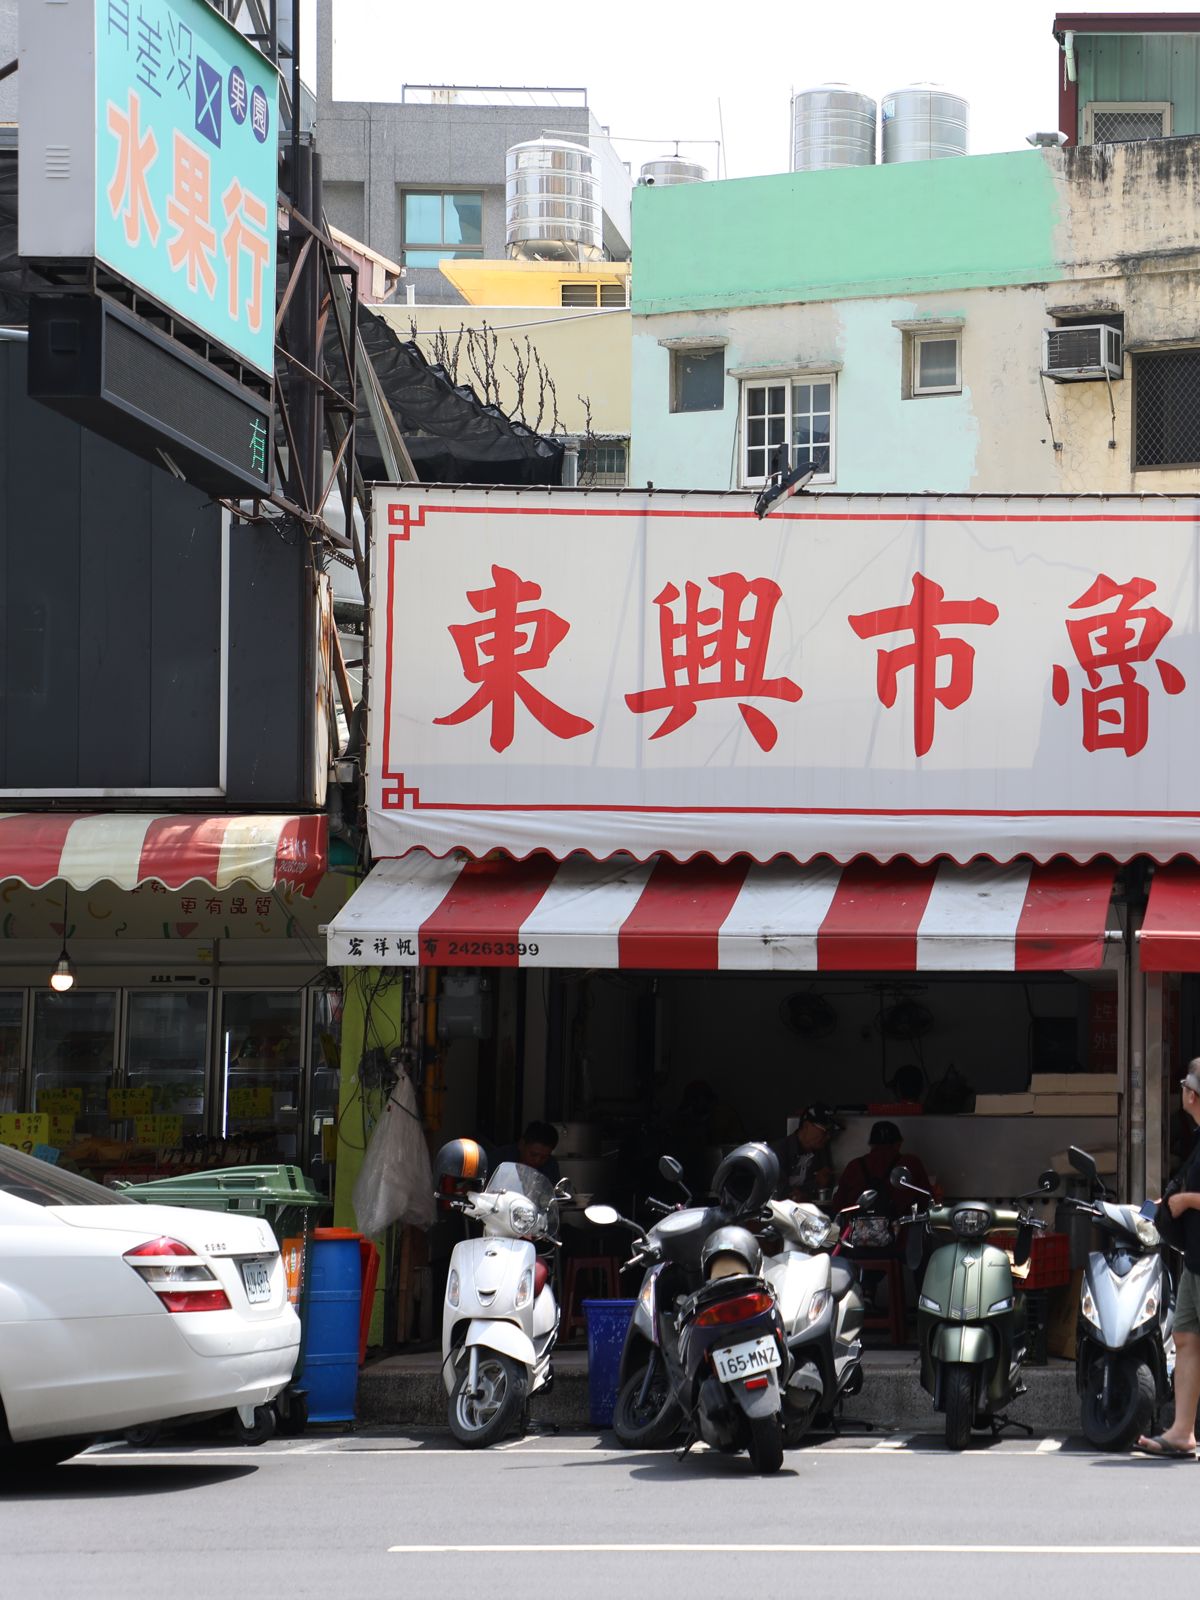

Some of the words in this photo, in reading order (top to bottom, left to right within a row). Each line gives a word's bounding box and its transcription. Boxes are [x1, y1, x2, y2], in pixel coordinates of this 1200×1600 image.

[230, 72, 267, 139] 果園
[106, 88, 271, 335] 水果行
[249, 418, 267, 474] 有
[181, 897, 272, 916] 更有品質
[347, 937, 440, 958] 宏祥帆布
[448, 942, 540, 956] 24263399
